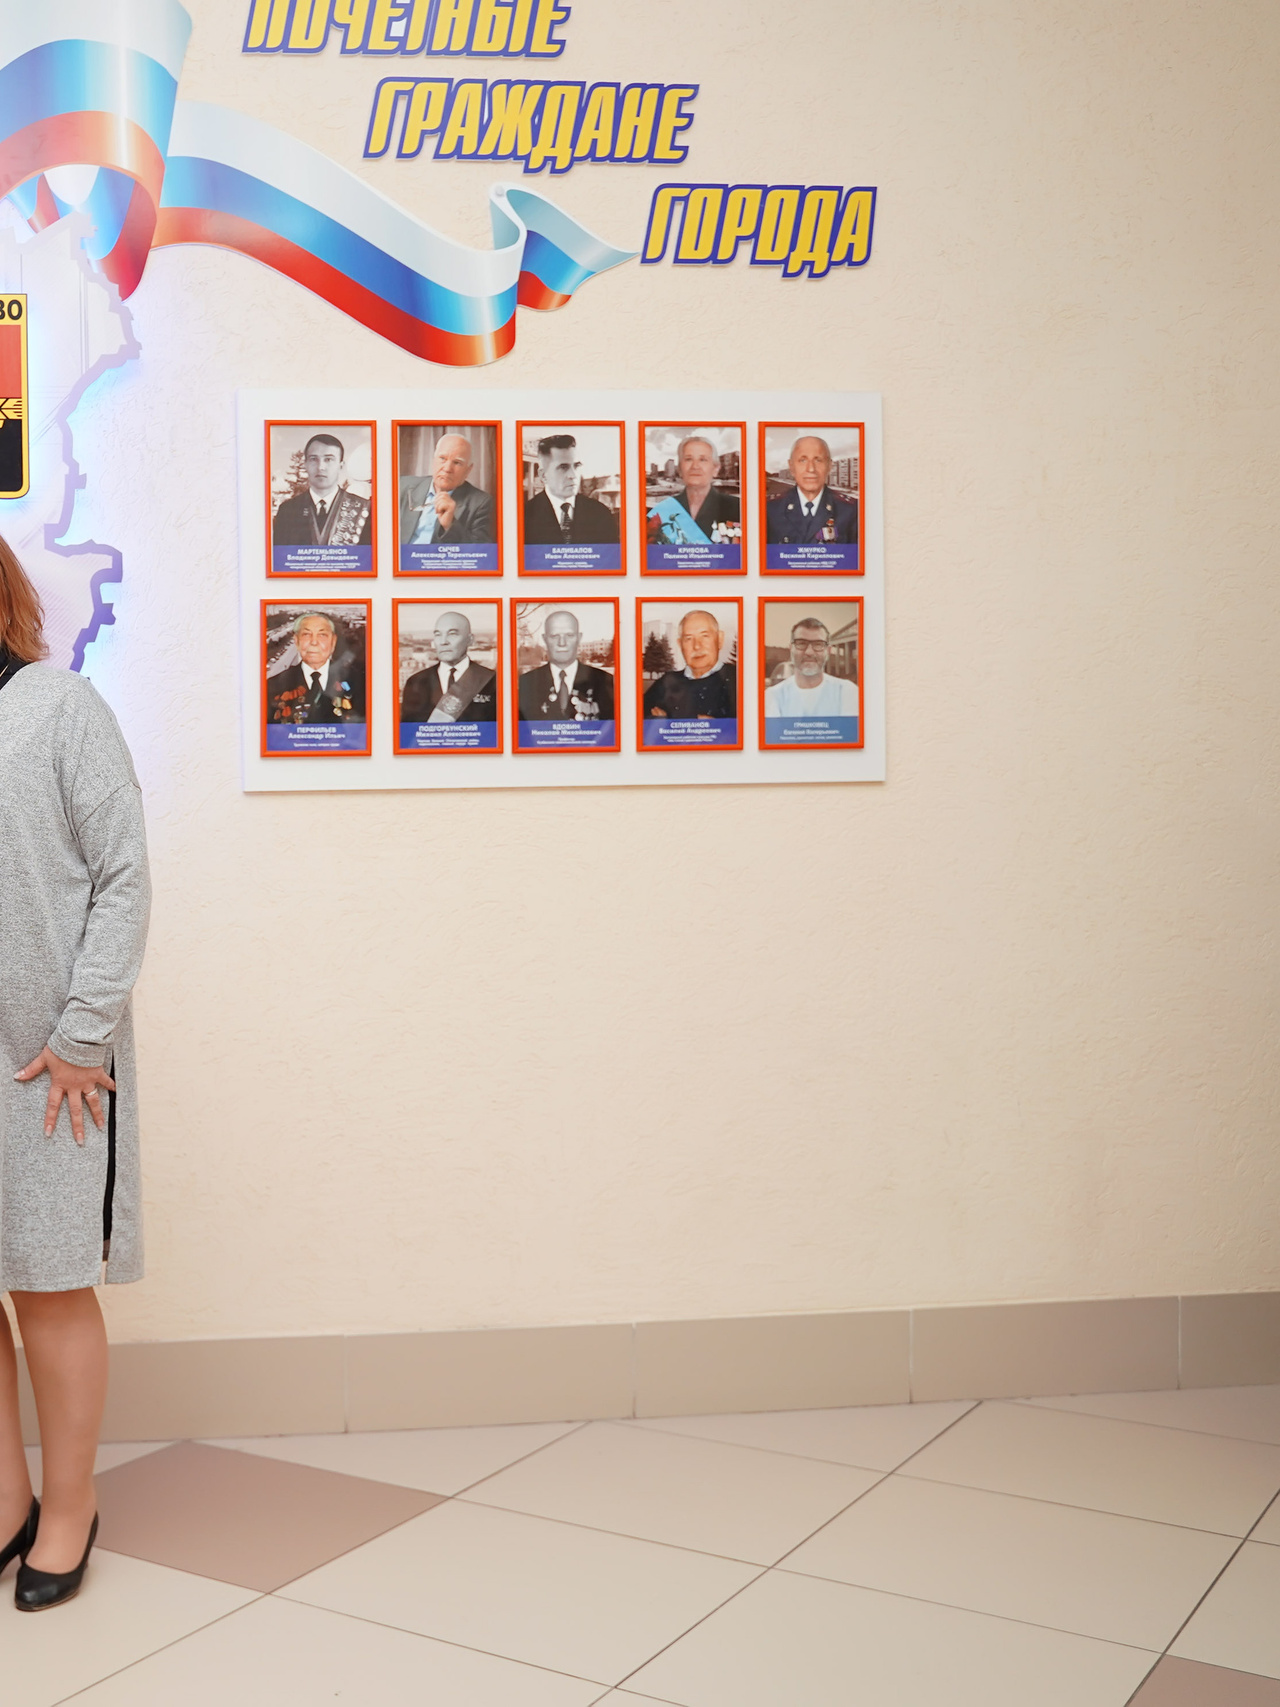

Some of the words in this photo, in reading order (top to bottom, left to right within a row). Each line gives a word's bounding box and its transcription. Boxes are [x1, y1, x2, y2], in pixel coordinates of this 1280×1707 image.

[363, 76, 700, 173] ГРАЖДАНЕ
[640, 182, 878, 278] ГОРОДА
[287, 554, 320, 562] Владимир
[419, 724, 478, 732] ПОДГОРБУНСКИЙ
